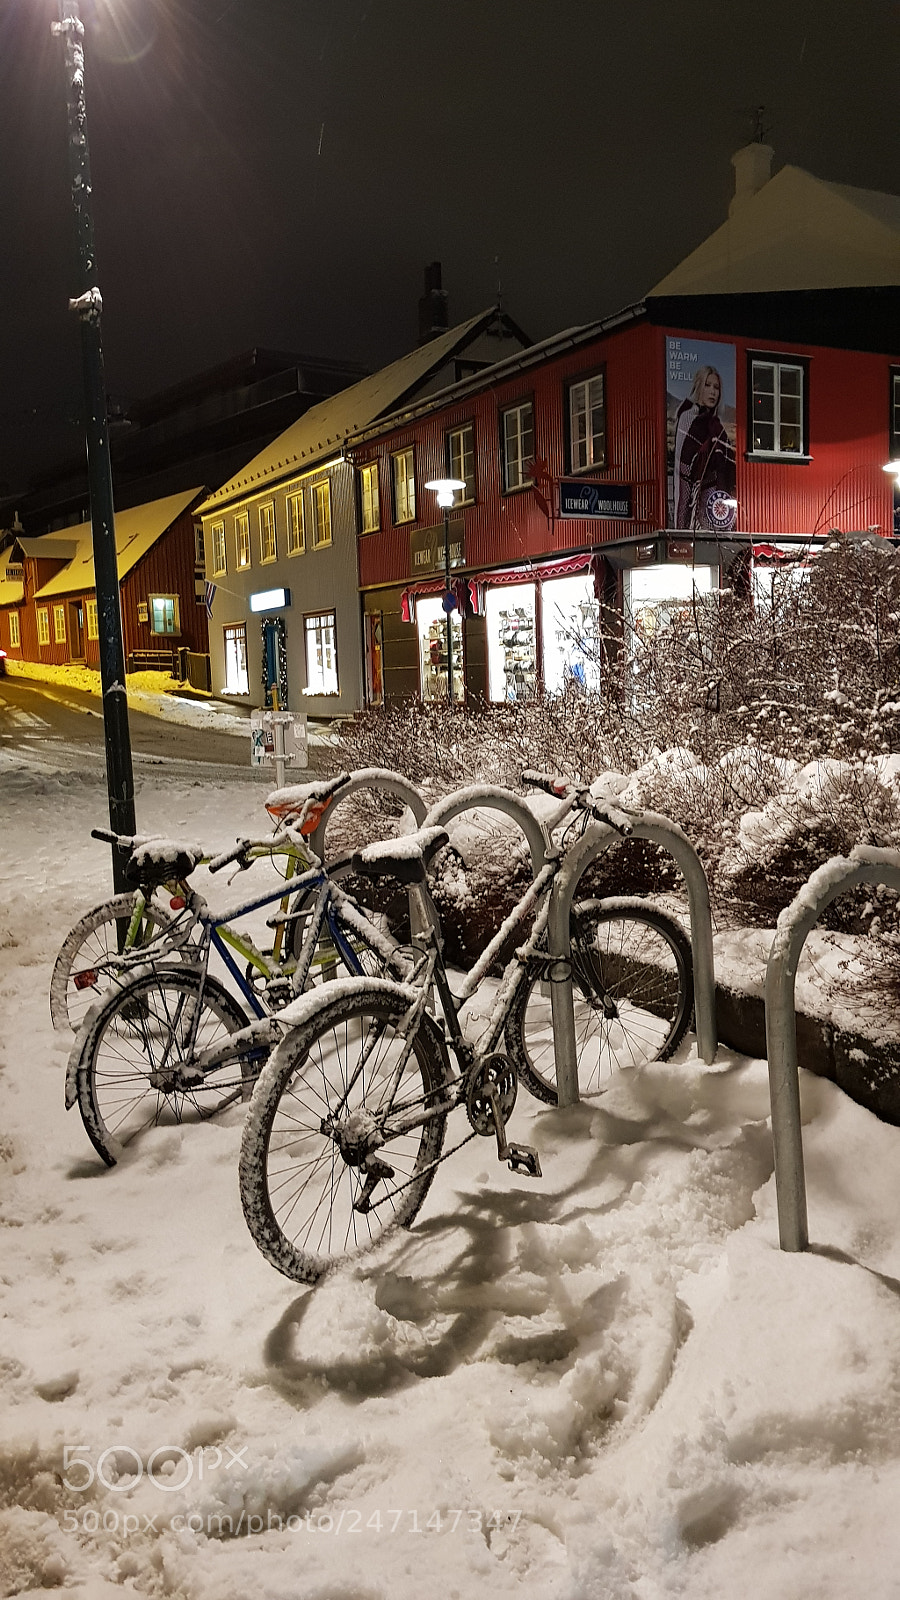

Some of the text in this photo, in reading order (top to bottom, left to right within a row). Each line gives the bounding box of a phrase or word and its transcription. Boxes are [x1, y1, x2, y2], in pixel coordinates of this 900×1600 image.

[669, 341, 681, 350] BE
[669, 351, 698, 362] WARM
[669, 361, 681, 370] BE
[669, 371, 693, 381] WELL
[565, 498, 629, 512] ICEWEAR WOOLHOUSE
